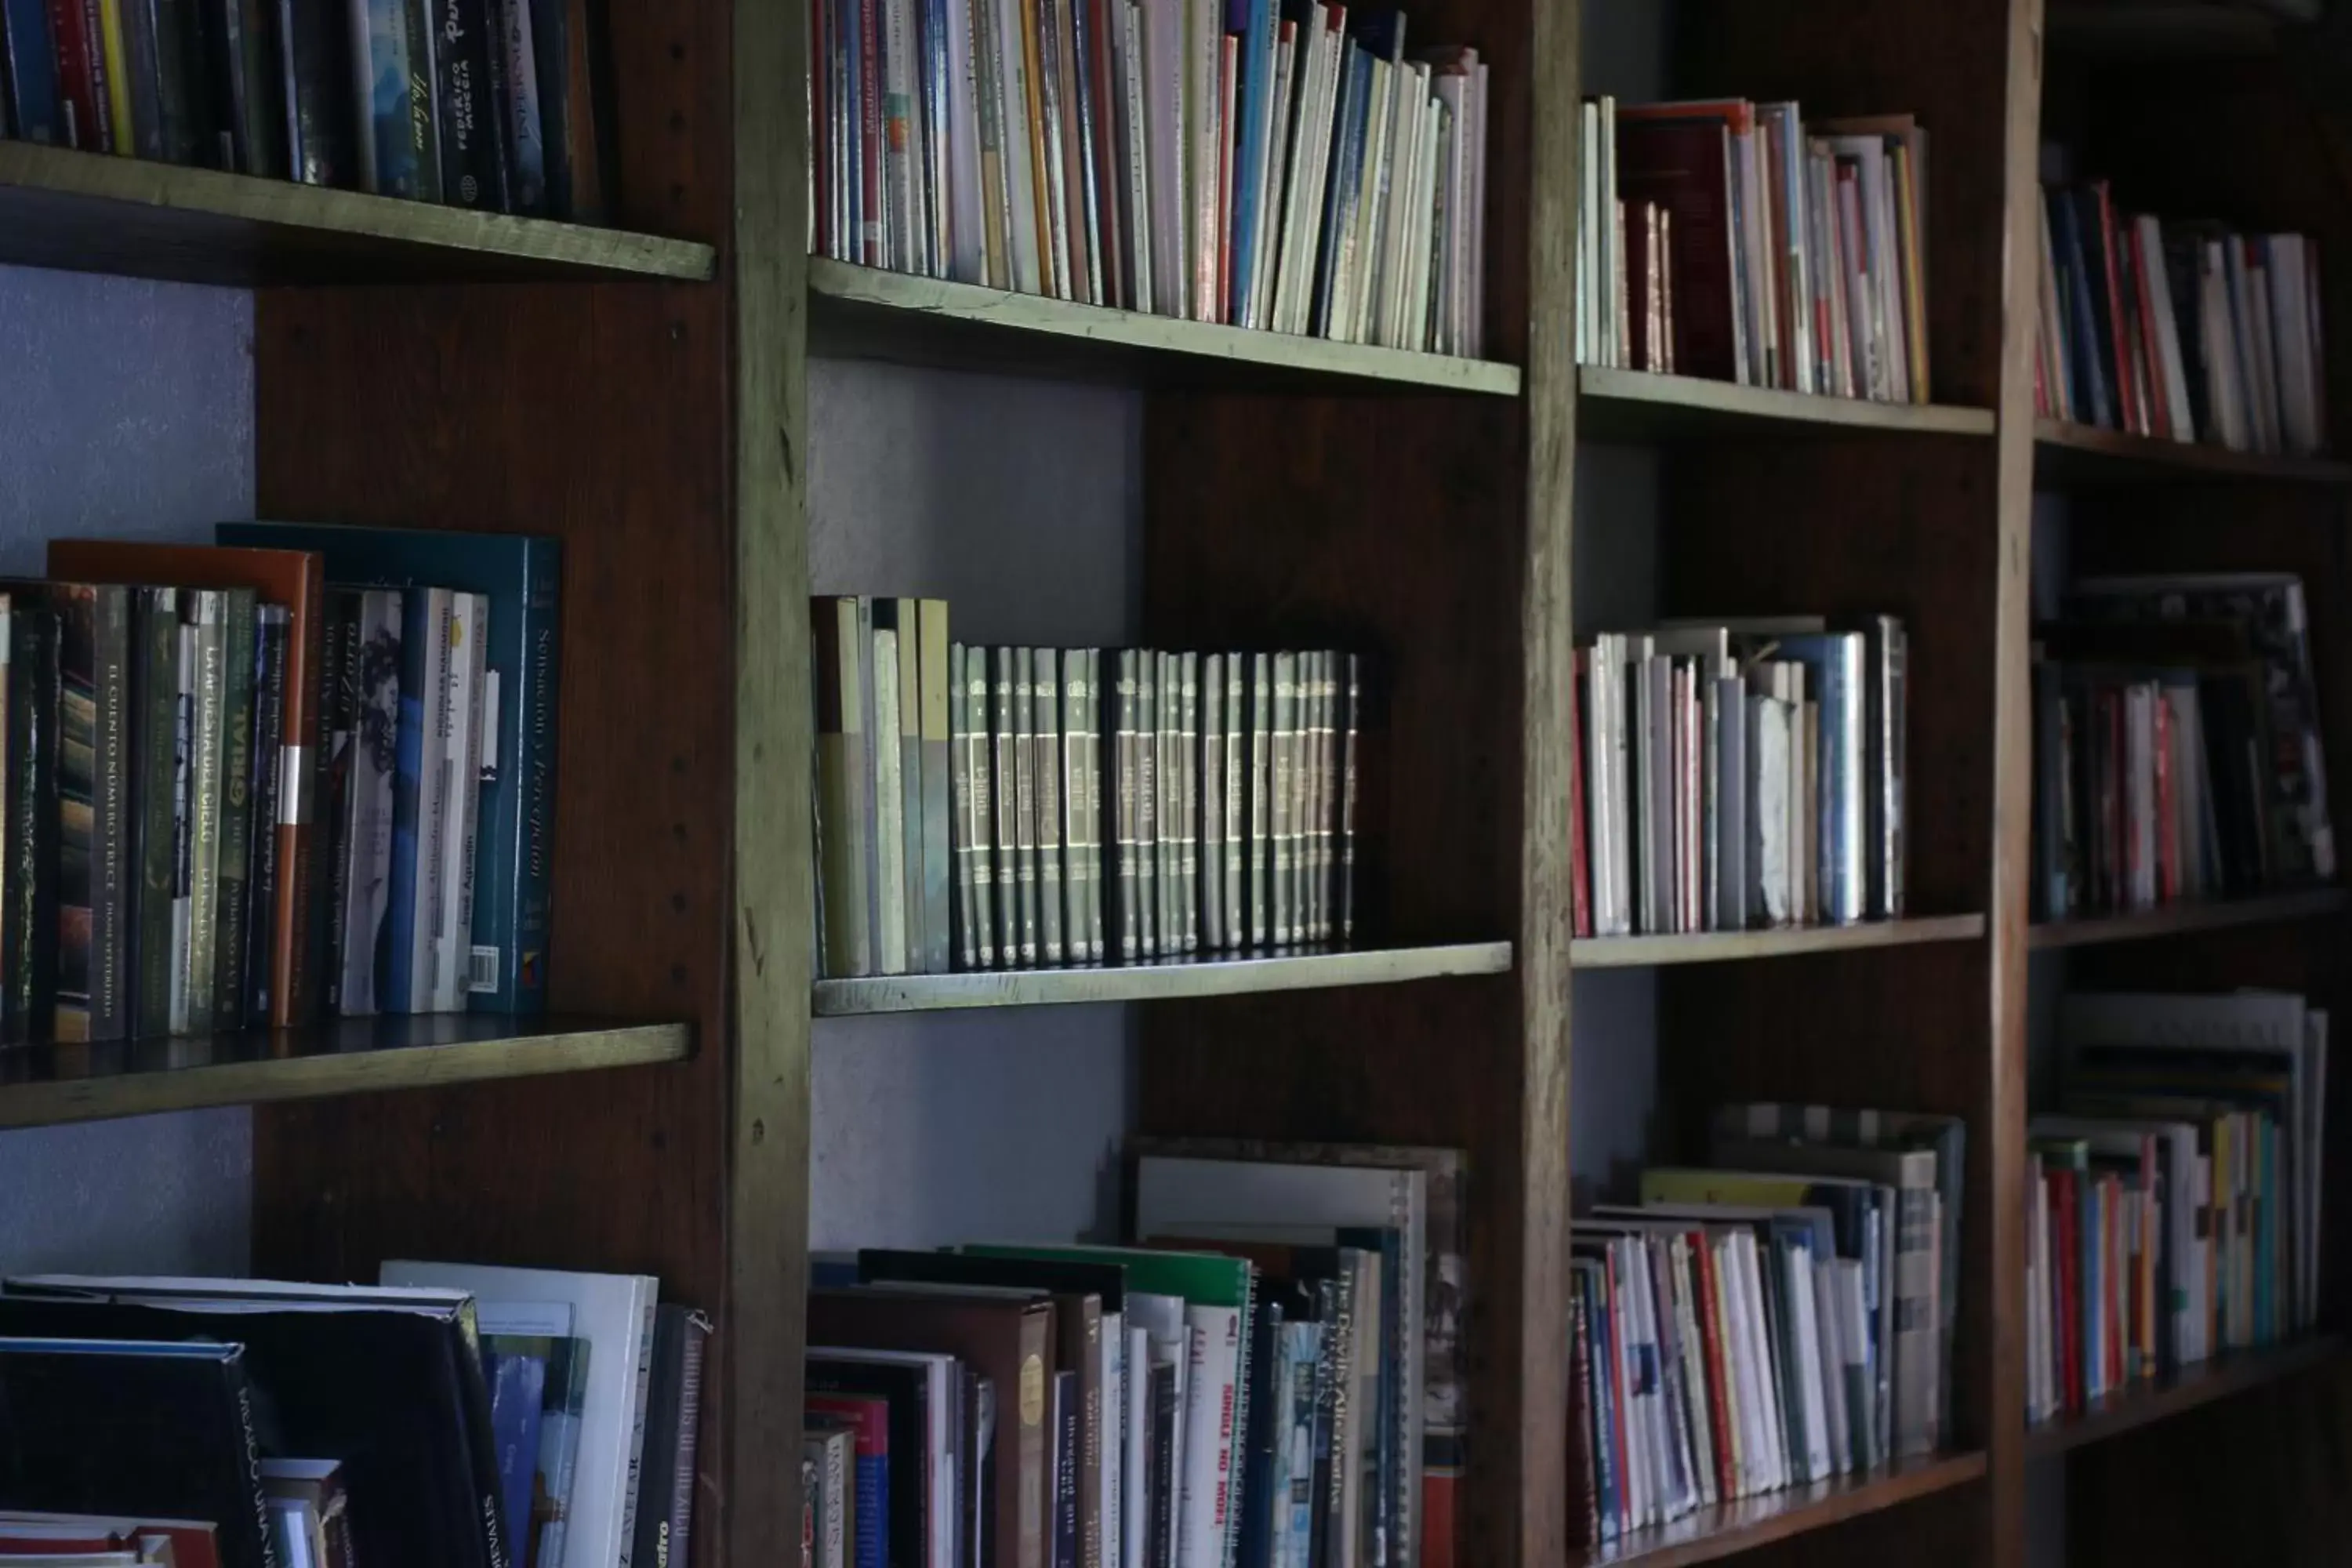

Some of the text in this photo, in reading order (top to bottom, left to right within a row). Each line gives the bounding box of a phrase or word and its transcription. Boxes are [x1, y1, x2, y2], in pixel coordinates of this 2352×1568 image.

[452, 59, 474, 151] FEDERICO MOCCIA
[108, 663, 118, 682] EL
[271, 637, 283, 693] Allende
[533, 627, 553, 734] Sensación
[107, 685, 118, 755] CUENTO
[227, 705, 249, 807] GRIAL
[200, 793, 215, 843] CIELO
[527, 759, 546, 879] Percepción
[106, 839, 116, 891] TRECE
[1338, 1267, 1353, 1310] The
